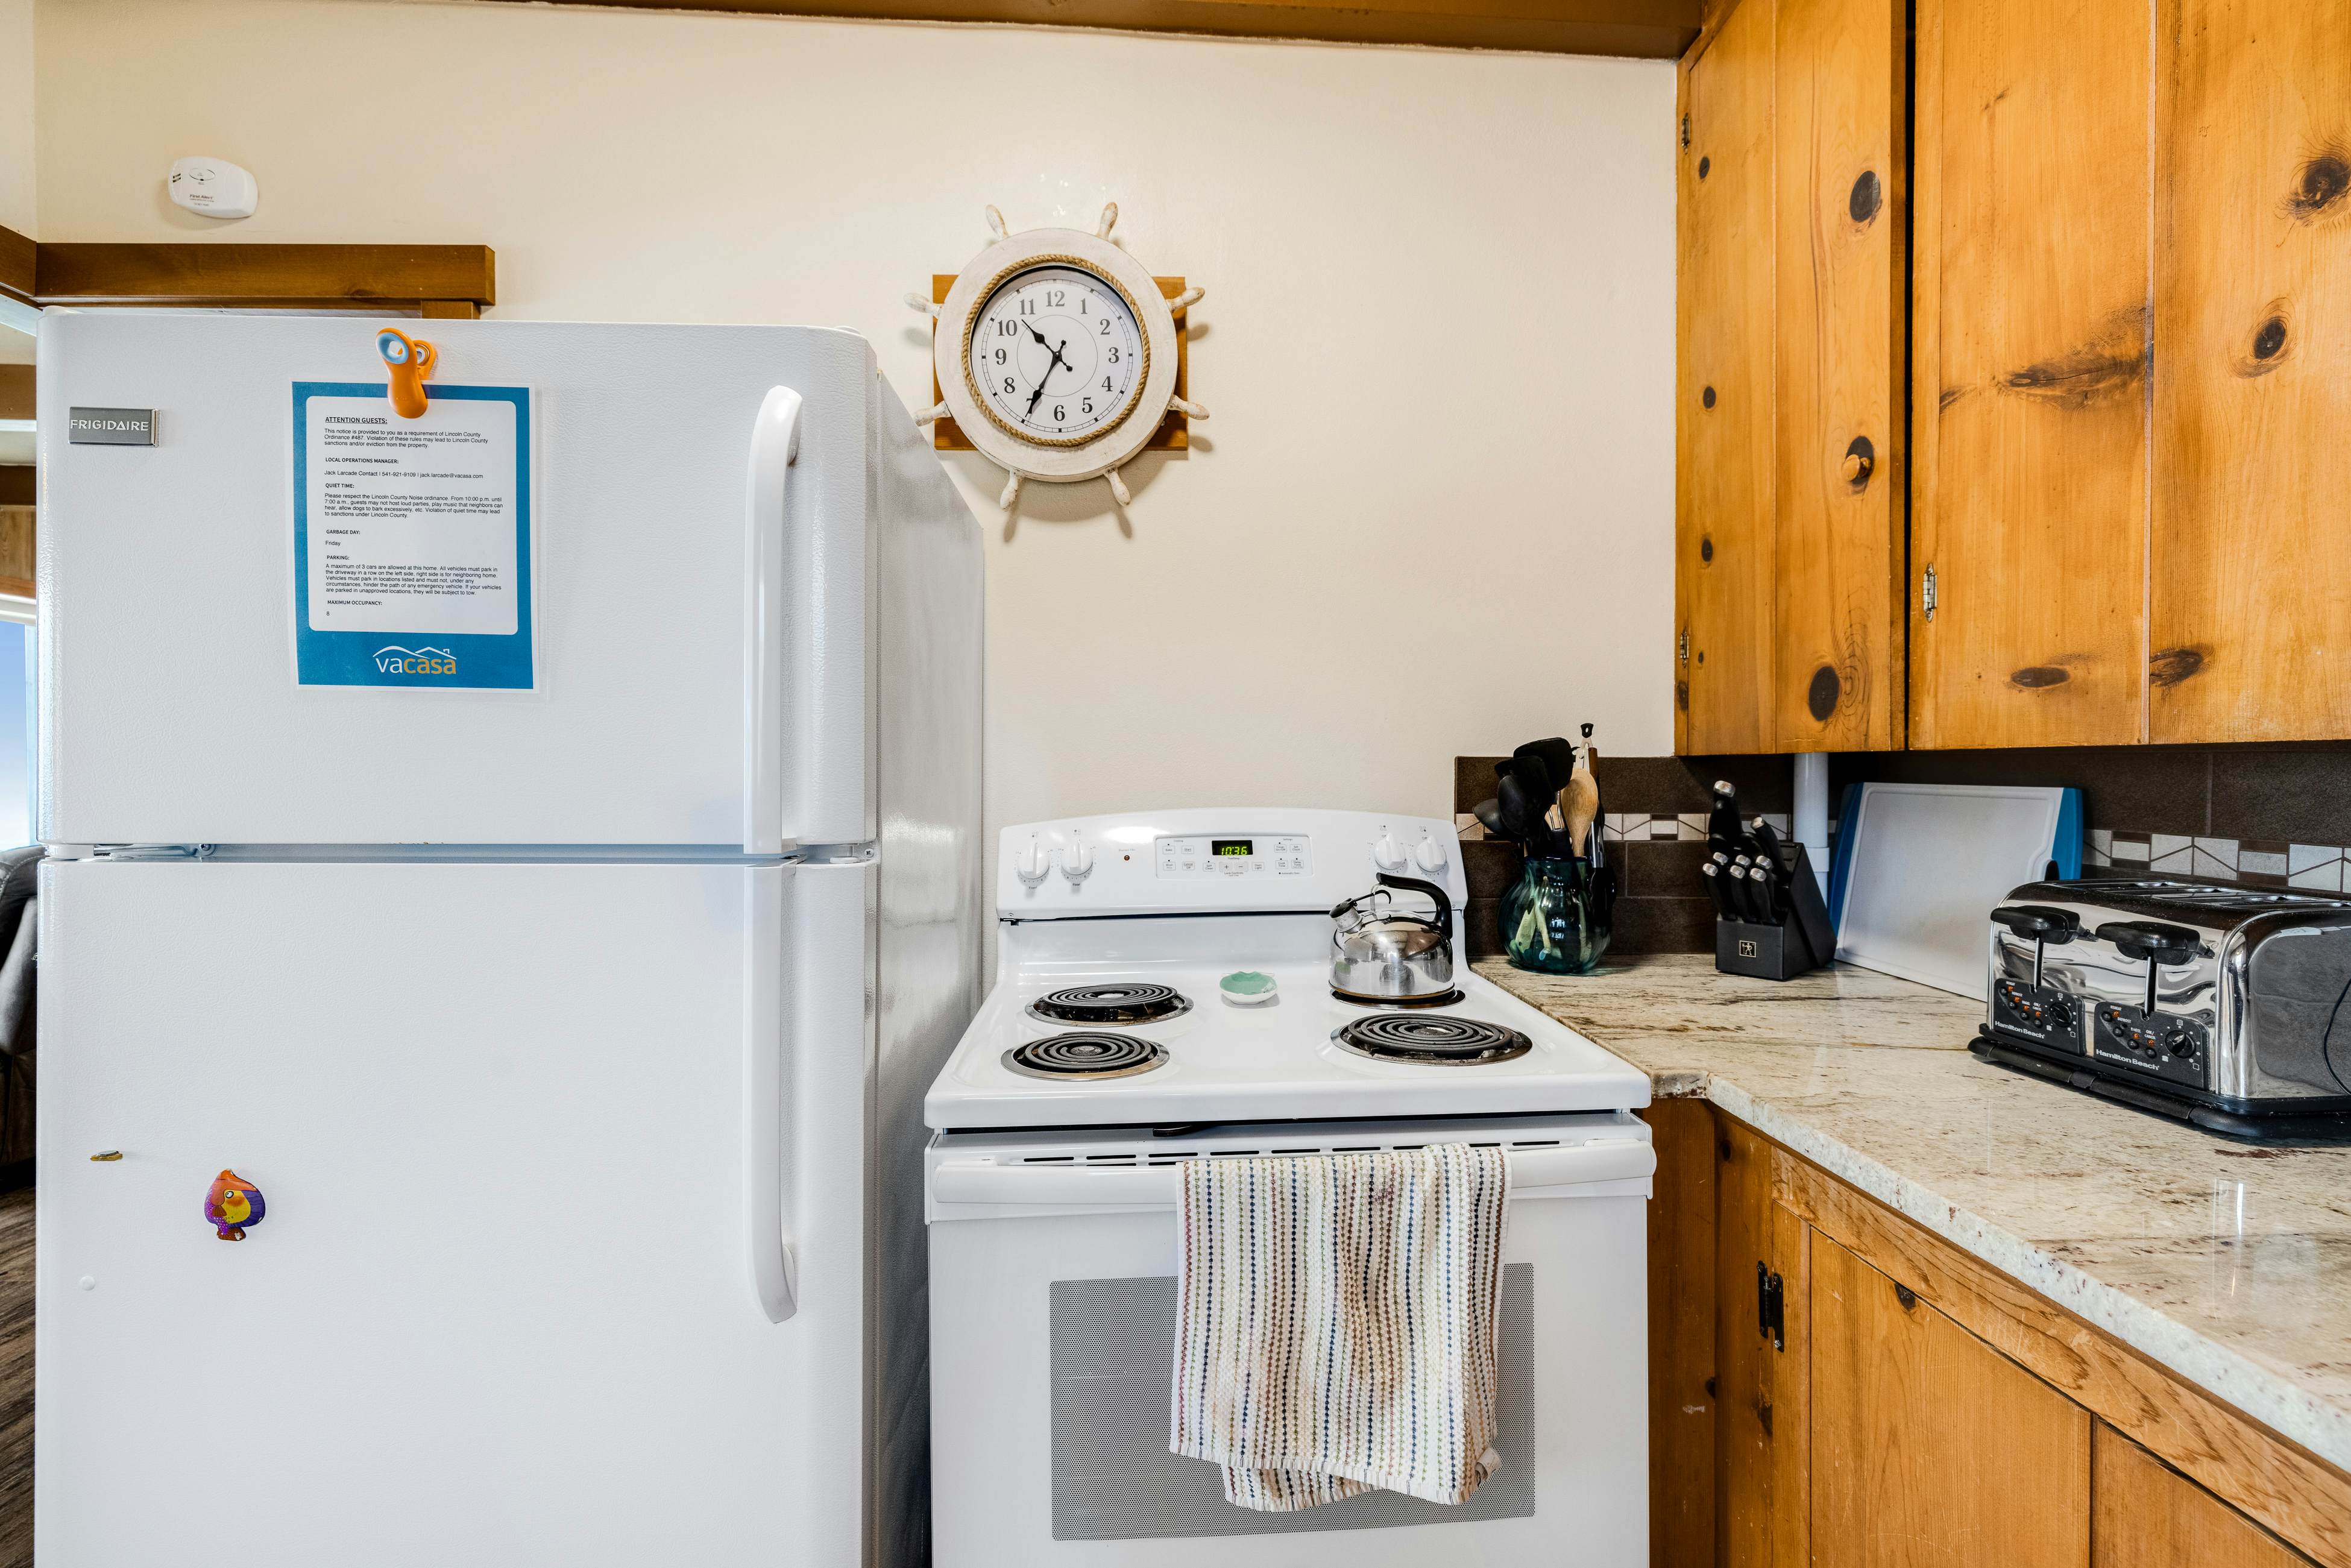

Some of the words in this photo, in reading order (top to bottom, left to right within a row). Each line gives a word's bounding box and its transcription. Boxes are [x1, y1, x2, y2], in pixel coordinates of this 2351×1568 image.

[1020, 299, 1036, 315] 11
[1046, 291, 1065, 307] 12
[1081, 298, 1087, 314] 1
[998, 320, 1017, 336] 10
[1100, 319, 1110, 335] 2
[995, 348, 1007, 365] 9
[1109, 347, 1119, 364] 3
[1004, 377, 1015, 394] 8
[1101, 376, 1113, 392] 4
[1054, 405, 1065, 421] 6
[1082, 397, 1093, 414] 5
[70, 420, 149, 431] FRIGIDAIRE
[376, 658, 456, 675] vacasa
[1221, 846, 1247, 855] 10:36
[1995, 1021, 2022, 1033] Hamilton
[2096, 1049, 2132, 1063] Hamilton
